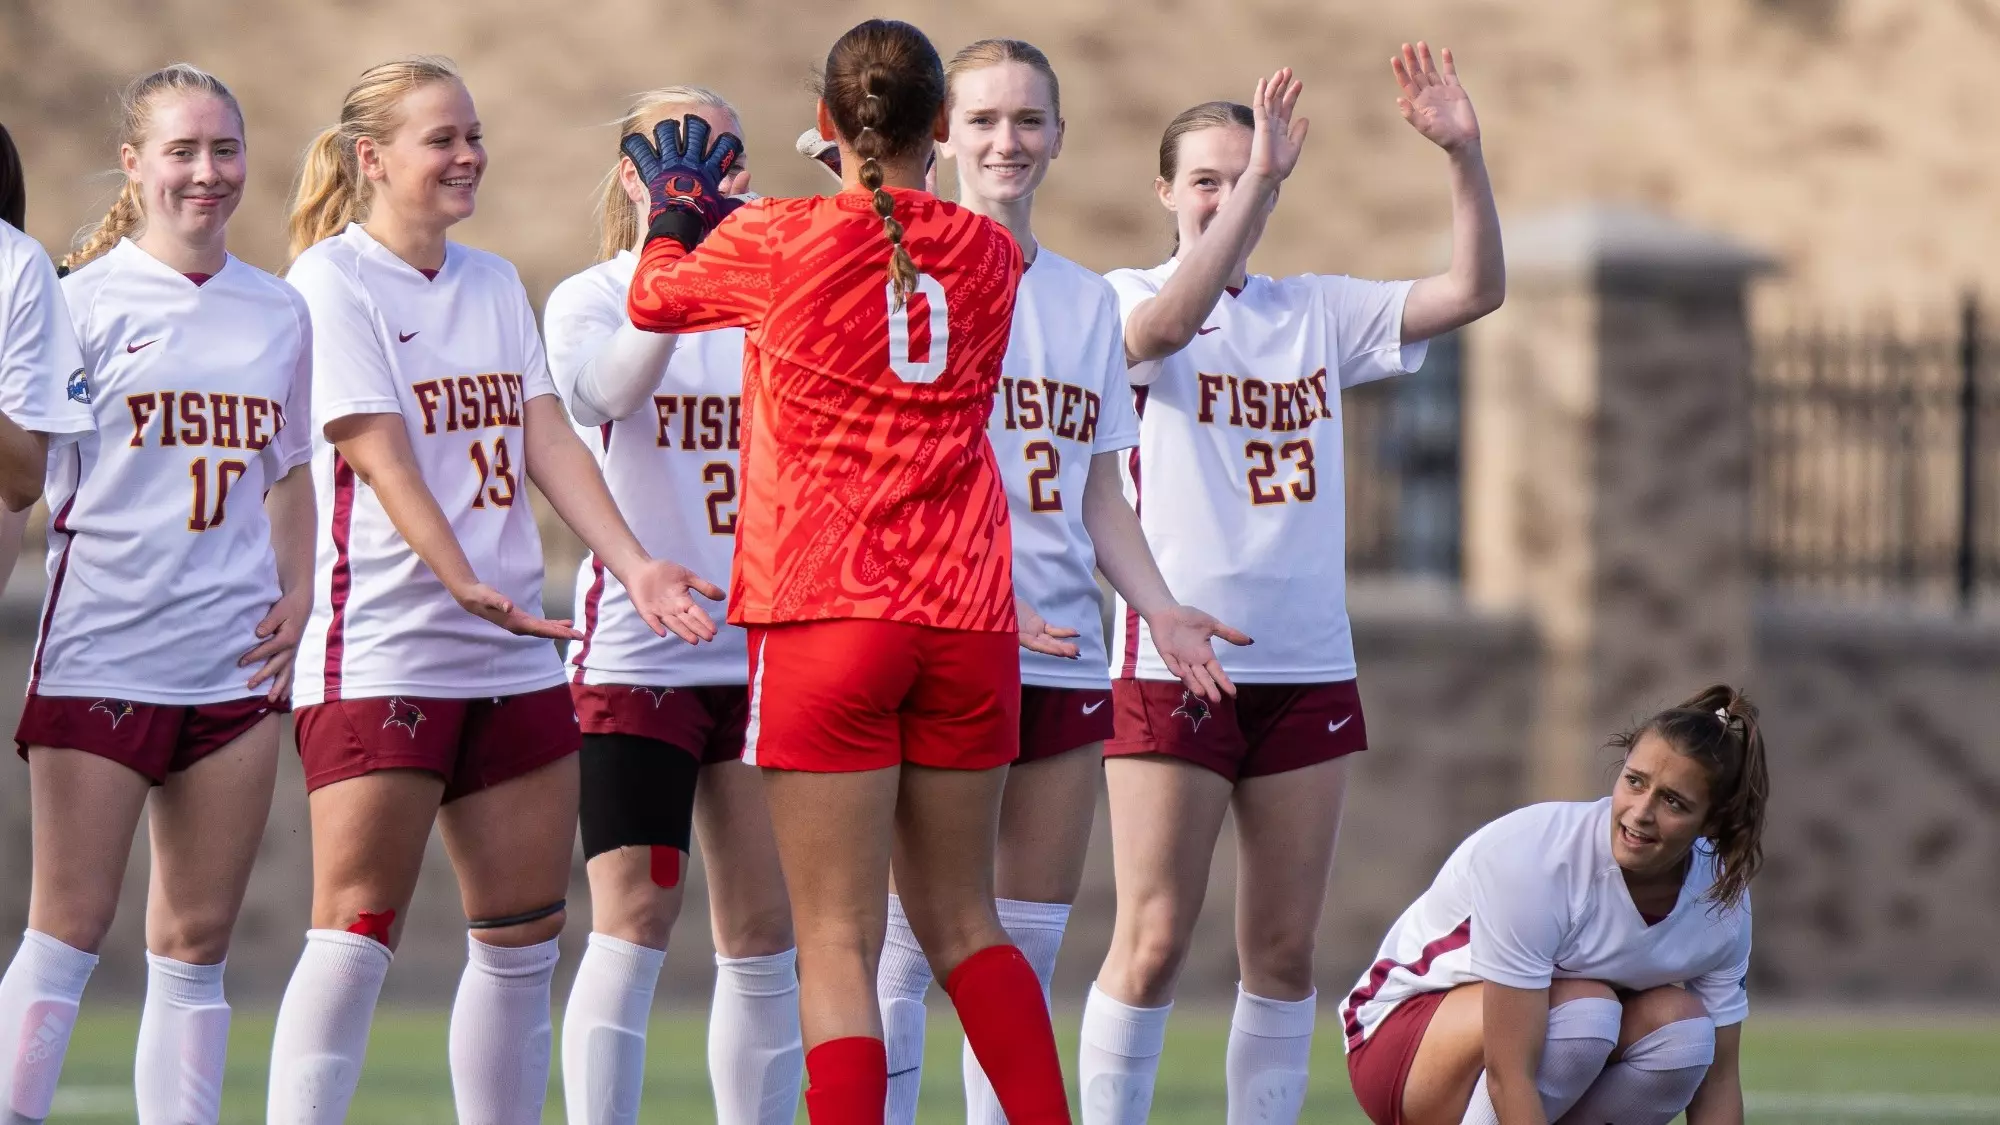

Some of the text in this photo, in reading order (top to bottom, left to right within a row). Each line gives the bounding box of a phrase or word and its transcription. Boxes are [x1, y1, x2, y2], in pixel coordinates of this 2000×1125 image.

[886, 273, 949, 384] 0
[411, 372, 524, 435] FISHE
[469, 436, 516, 509] 13
[1024, 440, 1063, 513] 2
[1245, 438, 1317, 506] 23
